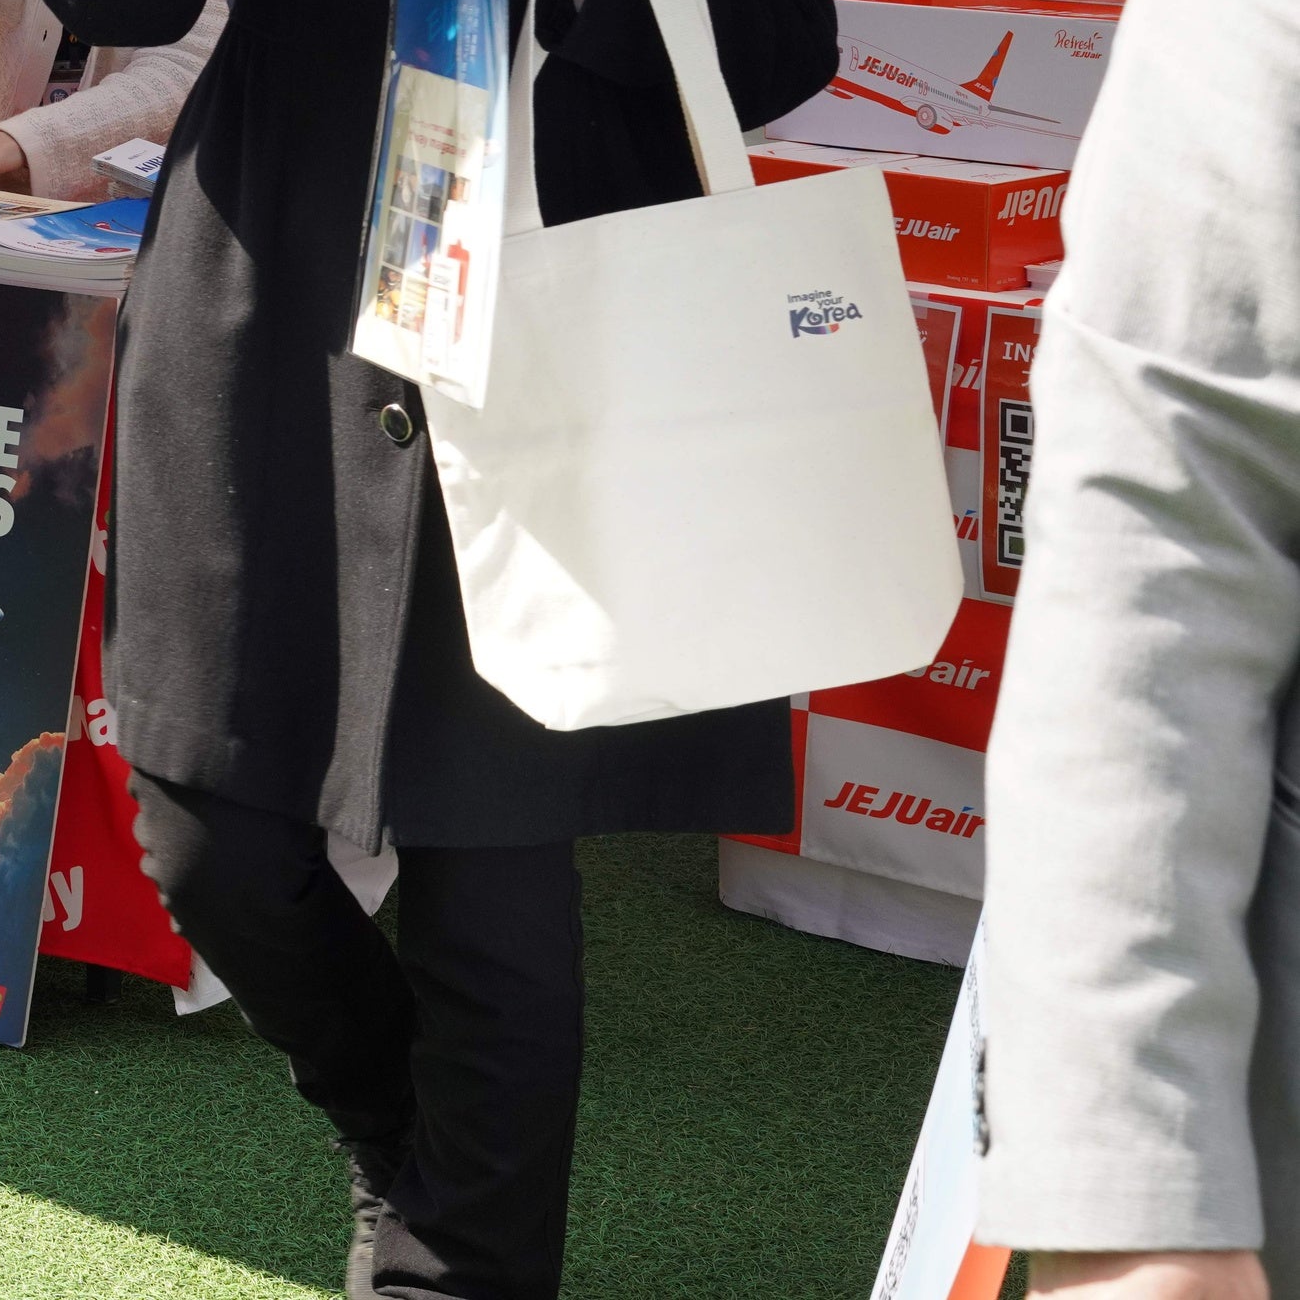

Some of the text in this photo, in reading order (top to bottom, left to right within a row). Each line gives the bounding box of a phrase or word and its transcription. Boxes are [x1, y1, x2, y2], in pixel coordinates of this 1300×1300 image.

[1054, 29, 1097, 52] Refresh
[1070, 50, 1103, 60] JEJUair
[857, 55, 918, 90] JEJUair
[787, 289, 833, 304] Imagine
[816, 296, 845, 310] your
[789, 302, 864, 339] Korea
[823, 781, 986, 839] JEJUair
